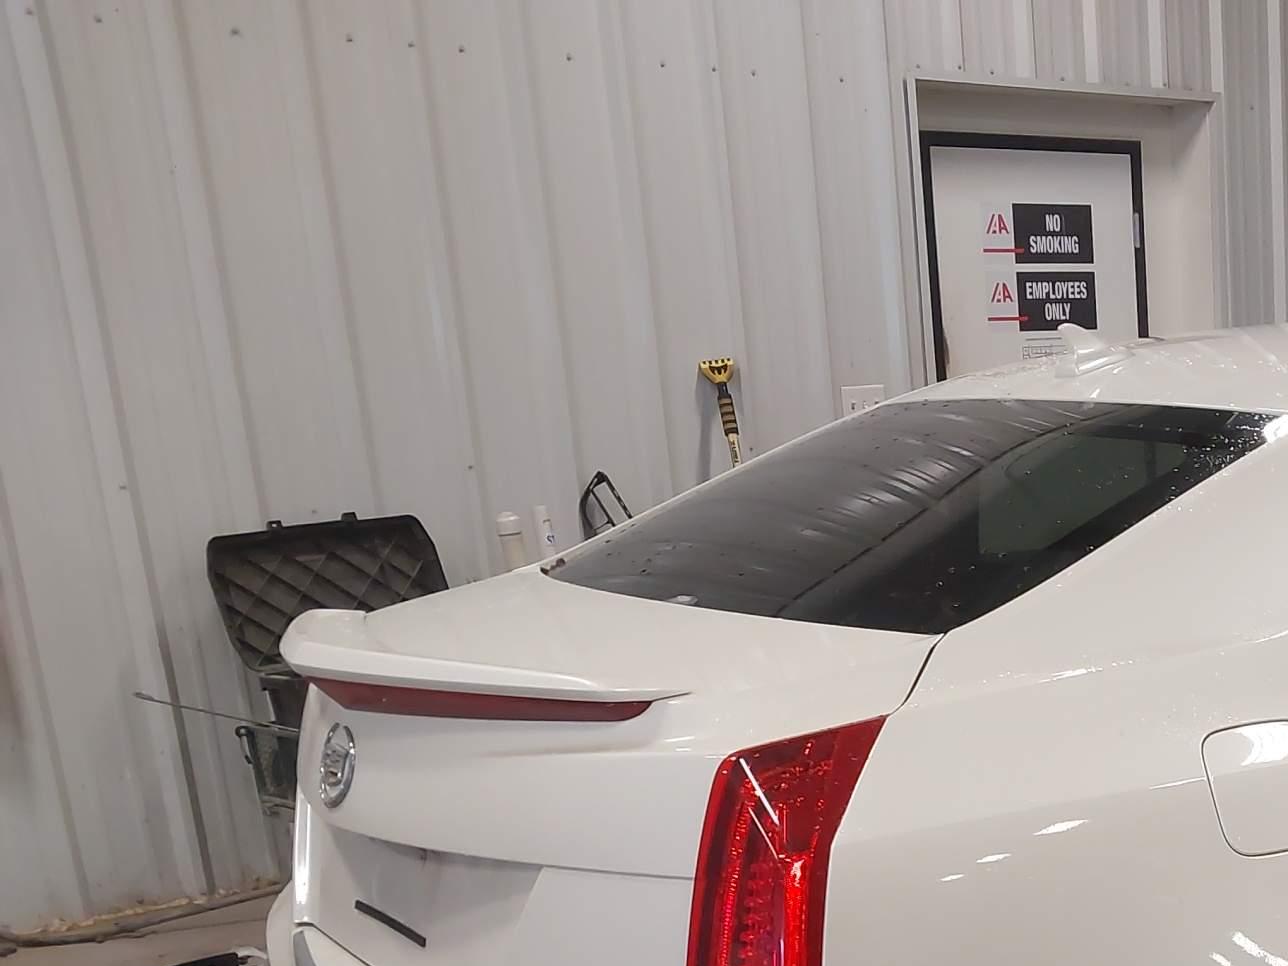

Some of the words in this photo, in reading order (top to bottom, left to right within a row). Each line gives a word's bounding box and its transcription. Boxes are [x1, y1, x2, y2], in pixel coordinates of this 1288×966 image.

[1045, 214, 1061, 232] NO
[1029, 236, 1079, 254] SMOKING
[1025, 281, 1088, 300] EMPLOYEES
[1044, 302, 1071, 321] ONLY
